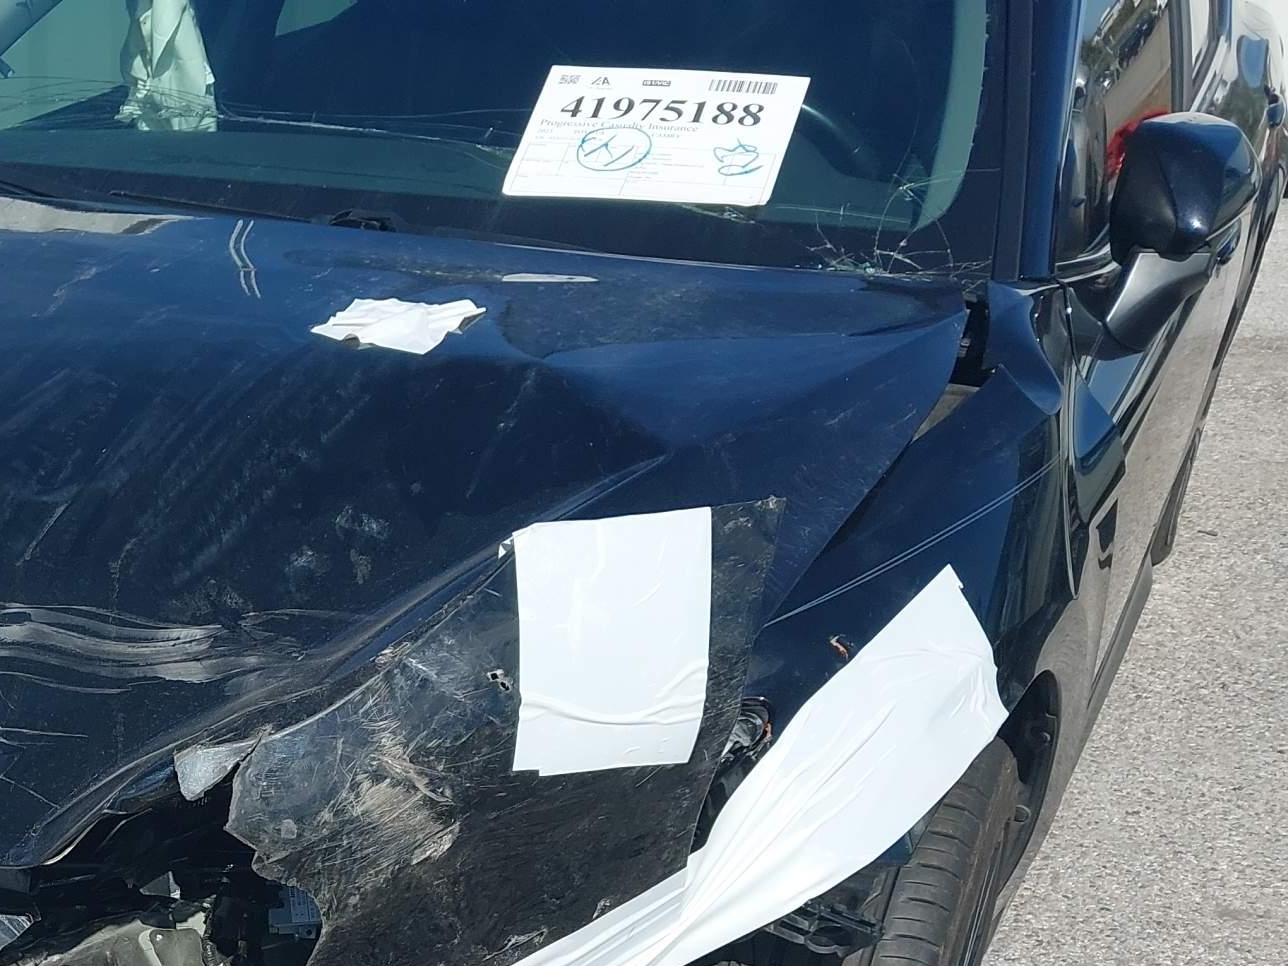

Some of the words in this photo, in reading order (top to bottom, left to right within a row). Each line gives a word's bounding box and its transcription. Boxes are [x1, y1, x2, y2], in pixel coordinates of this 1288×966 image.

[561, 96, 765, 127] 41975188
[540, 119, 599, 129] Progressive
[648, 122, 699, 132] Insurance
